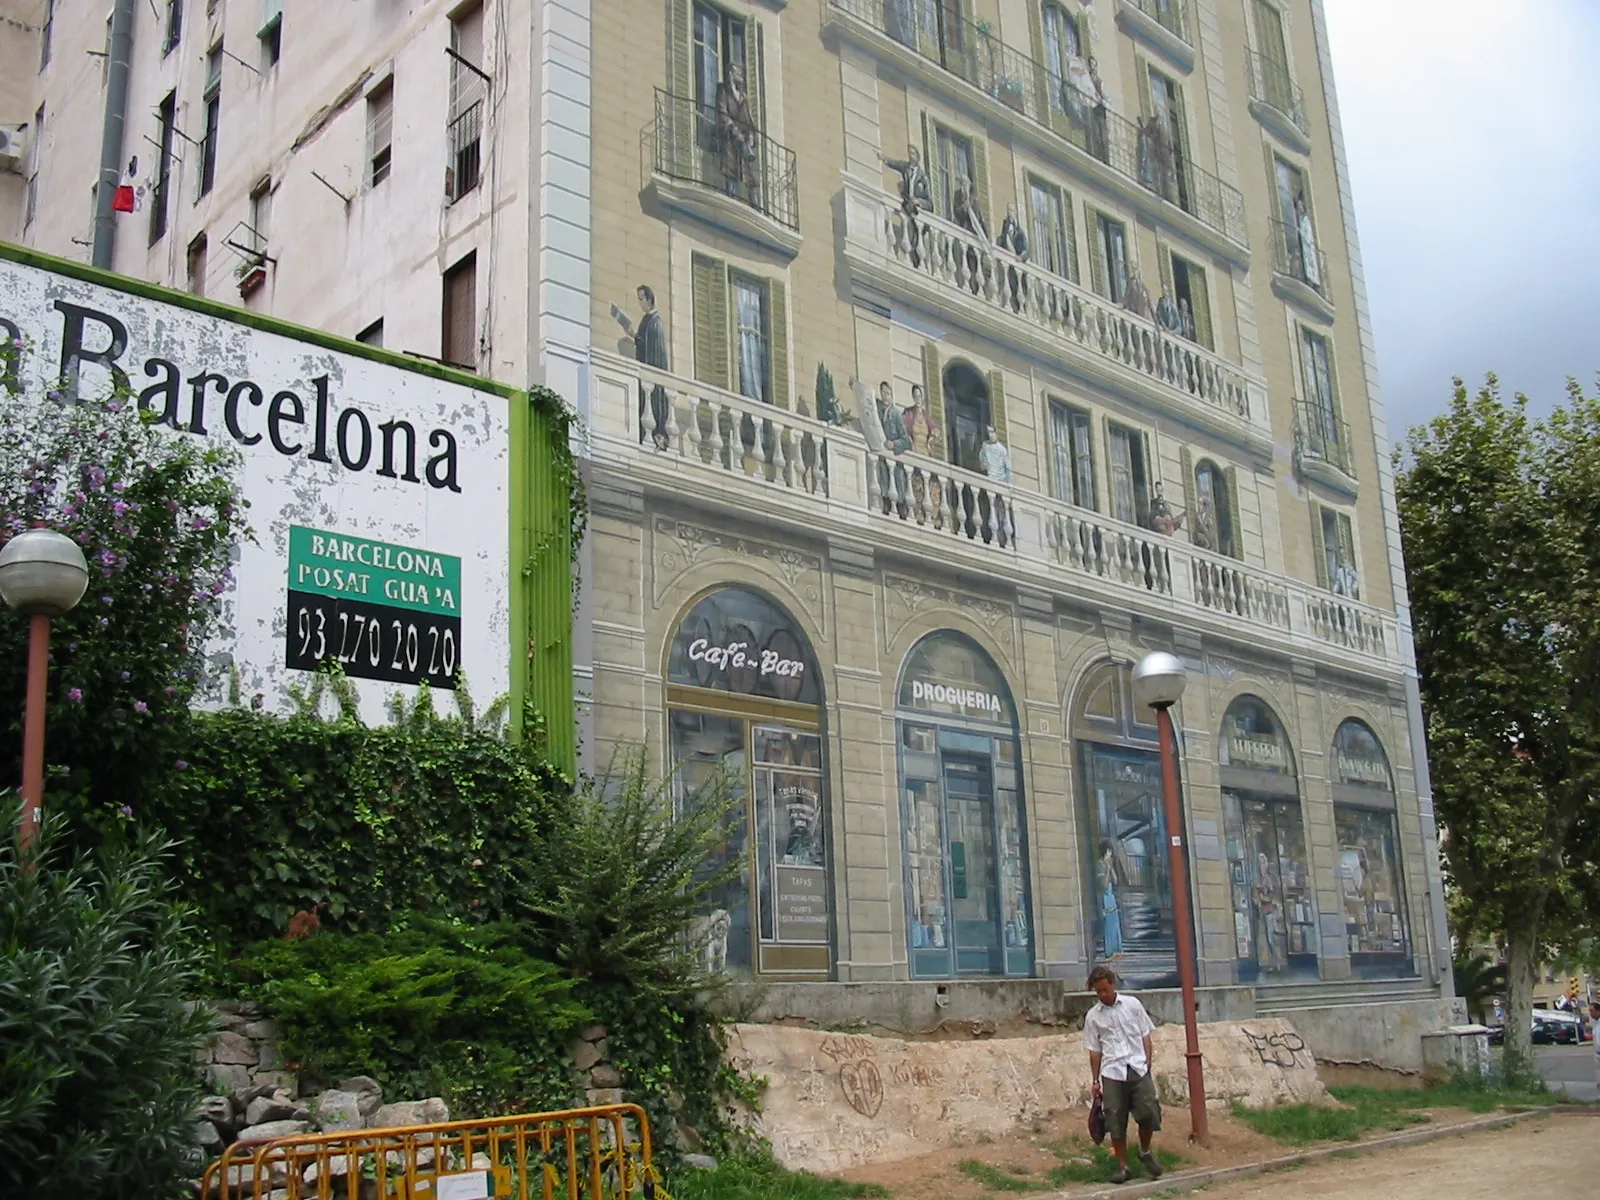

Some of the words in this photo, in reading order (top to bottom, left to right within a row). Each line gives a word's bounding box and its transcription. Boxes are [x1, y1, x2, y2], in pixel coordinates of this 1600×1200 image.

[51, 299, 463, 494] Barcelona
[312, 535, 445, 578] BARCELONA
[298, 607, 328, 660] 93
[391, 619, 418, 673] 20
[427, 626, 456, 677] 20
[912, 680, 1002, 713] DROGUERIA
